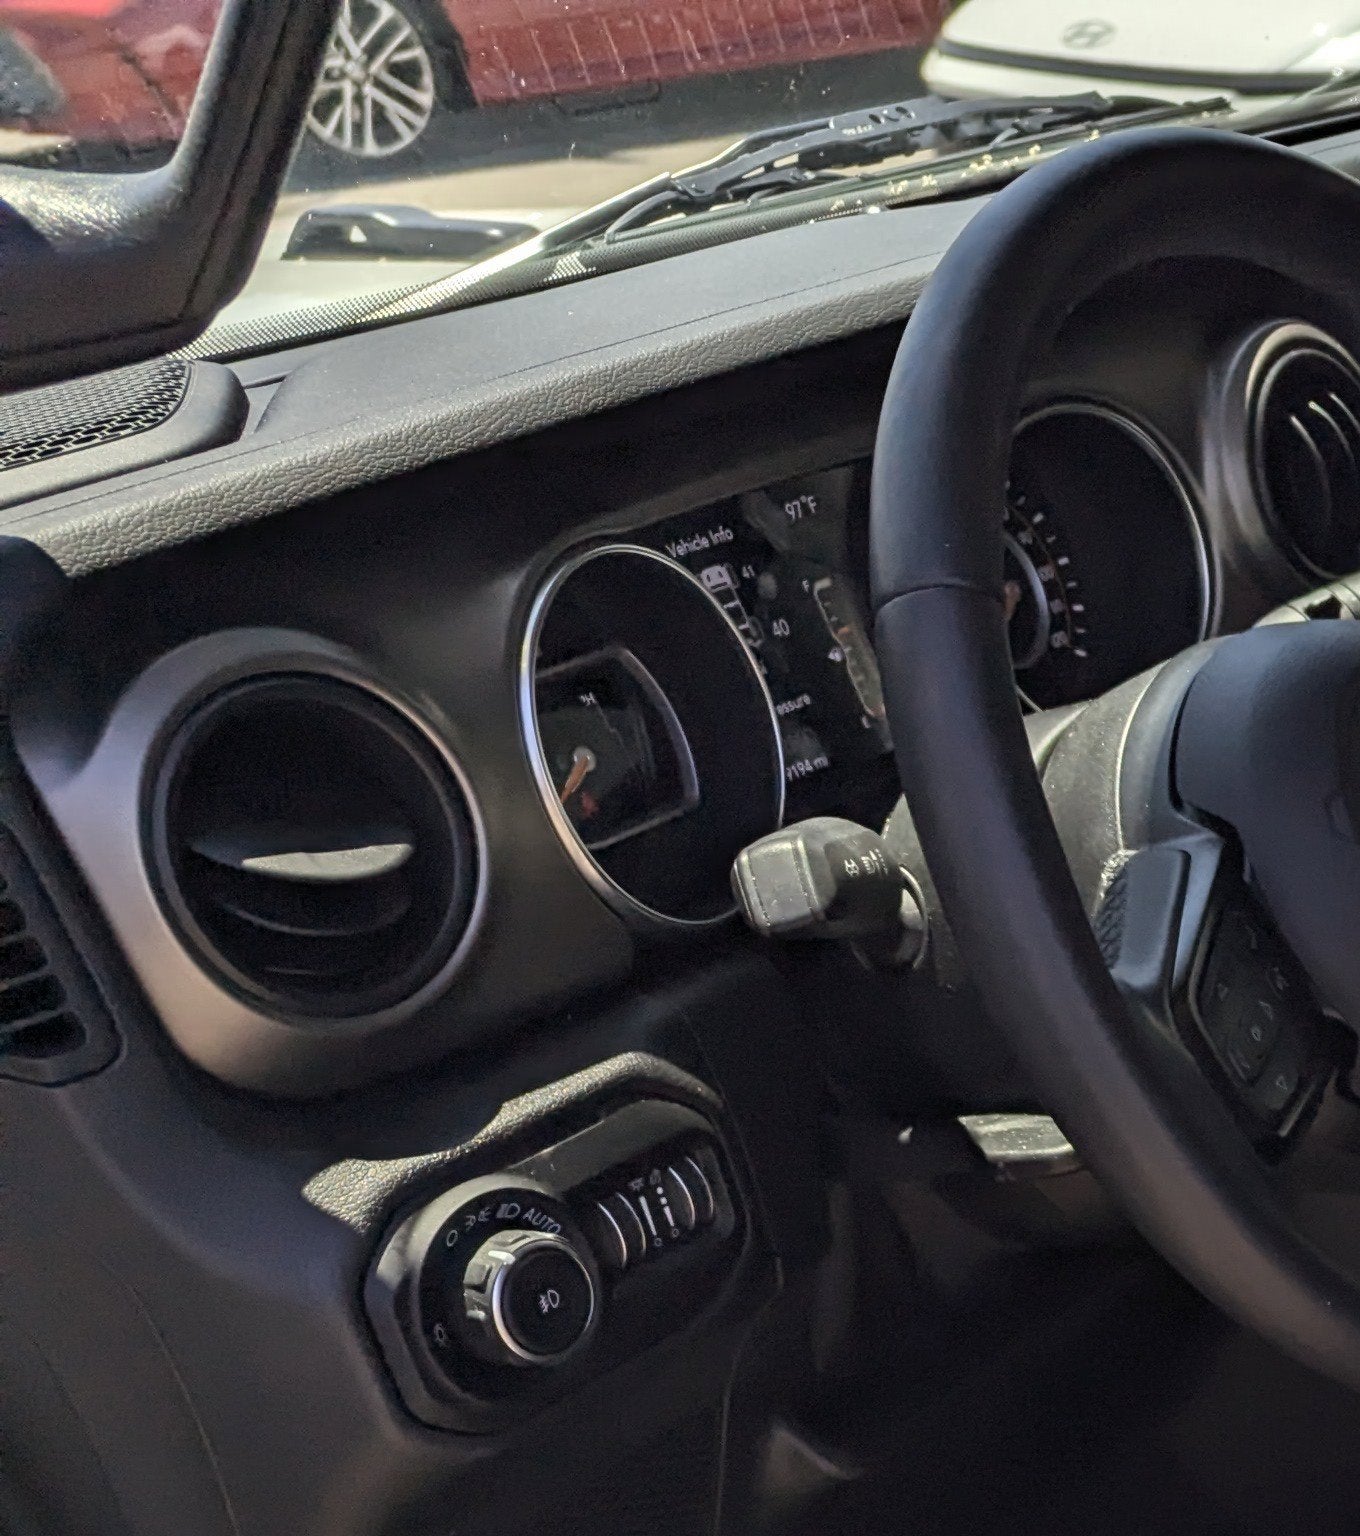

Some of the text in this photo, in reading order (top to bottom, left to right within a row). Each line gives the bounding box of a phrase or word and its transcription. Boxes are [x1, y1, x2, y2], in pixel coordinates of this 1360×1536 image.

[665, 525, 735, 559] Vehicle Info
[772, 618, 790, 637] 40
[522, 1208, 561, 1234] AUTO
